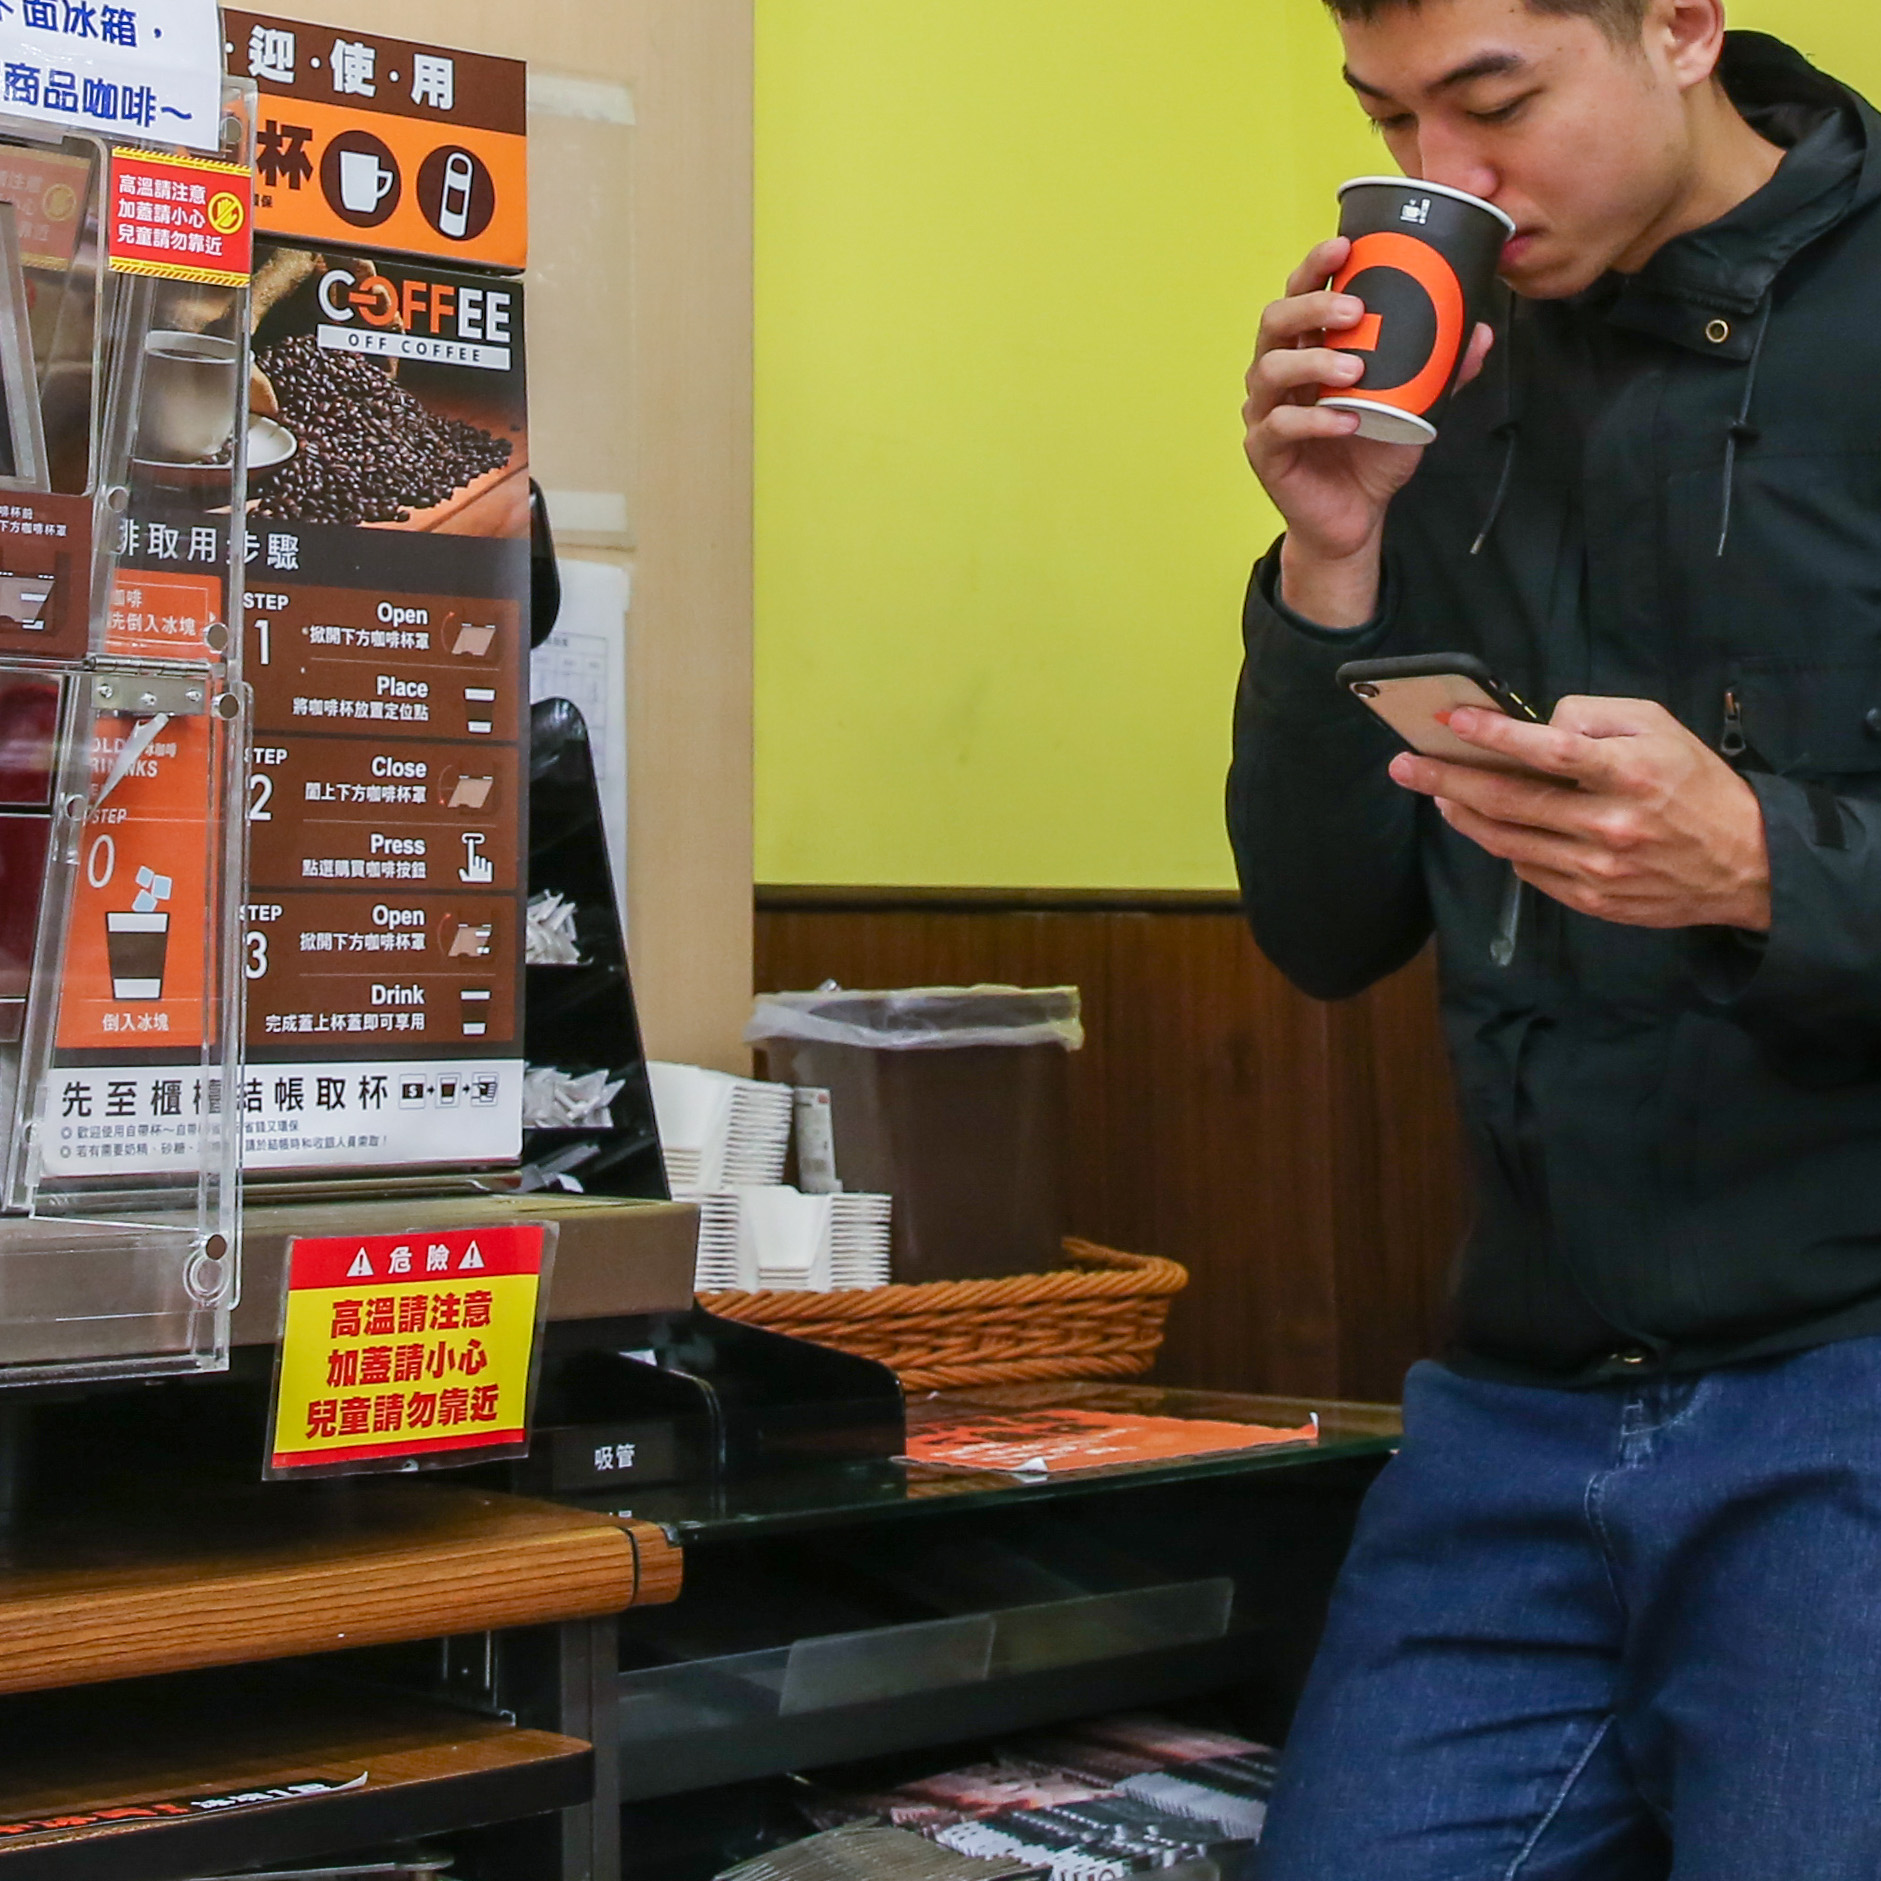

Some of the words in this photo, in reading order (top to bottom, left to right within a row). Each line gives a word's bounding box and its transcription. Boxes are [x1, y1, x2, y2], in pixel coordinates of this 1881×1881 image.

[118, 173, 207, 206] 高溫請注意
[117, 198, 207, 230] 加蓋請小心
[116, 223, 223, 257] 兒童請勿靠近
[317, 268, 512, 344] COFFEE
[348, 333, 388, 351] OFF
[401, 339, 482, 364] COFFEE
[243, 591, 290, 611] STEP
[376, 601, 429, 627] Open
[253, 619, 270, 666] 1
[376, 675, 429, 699] Place
[371, 755, 428, 779] Close
[248, 773, 274, 822] 2
[370, 833, 427, 856] Press
[371, 904, 426, 931] Open
[245, 930, 269, 980] 3
[371, 983, 426, 1005] Drink
[102, 1011, 170, 1033] 倒入冰塊
[388, 1243, 451, 1275] 危險
[330, 1290, 493, 1339] 高溫請注意
[327, 1338, 489, 1388] 加蓋請小心
[305, 1383, 500, 1440] 兒童請勿靠近
[594, 1442, 636, 1471] 吸管
